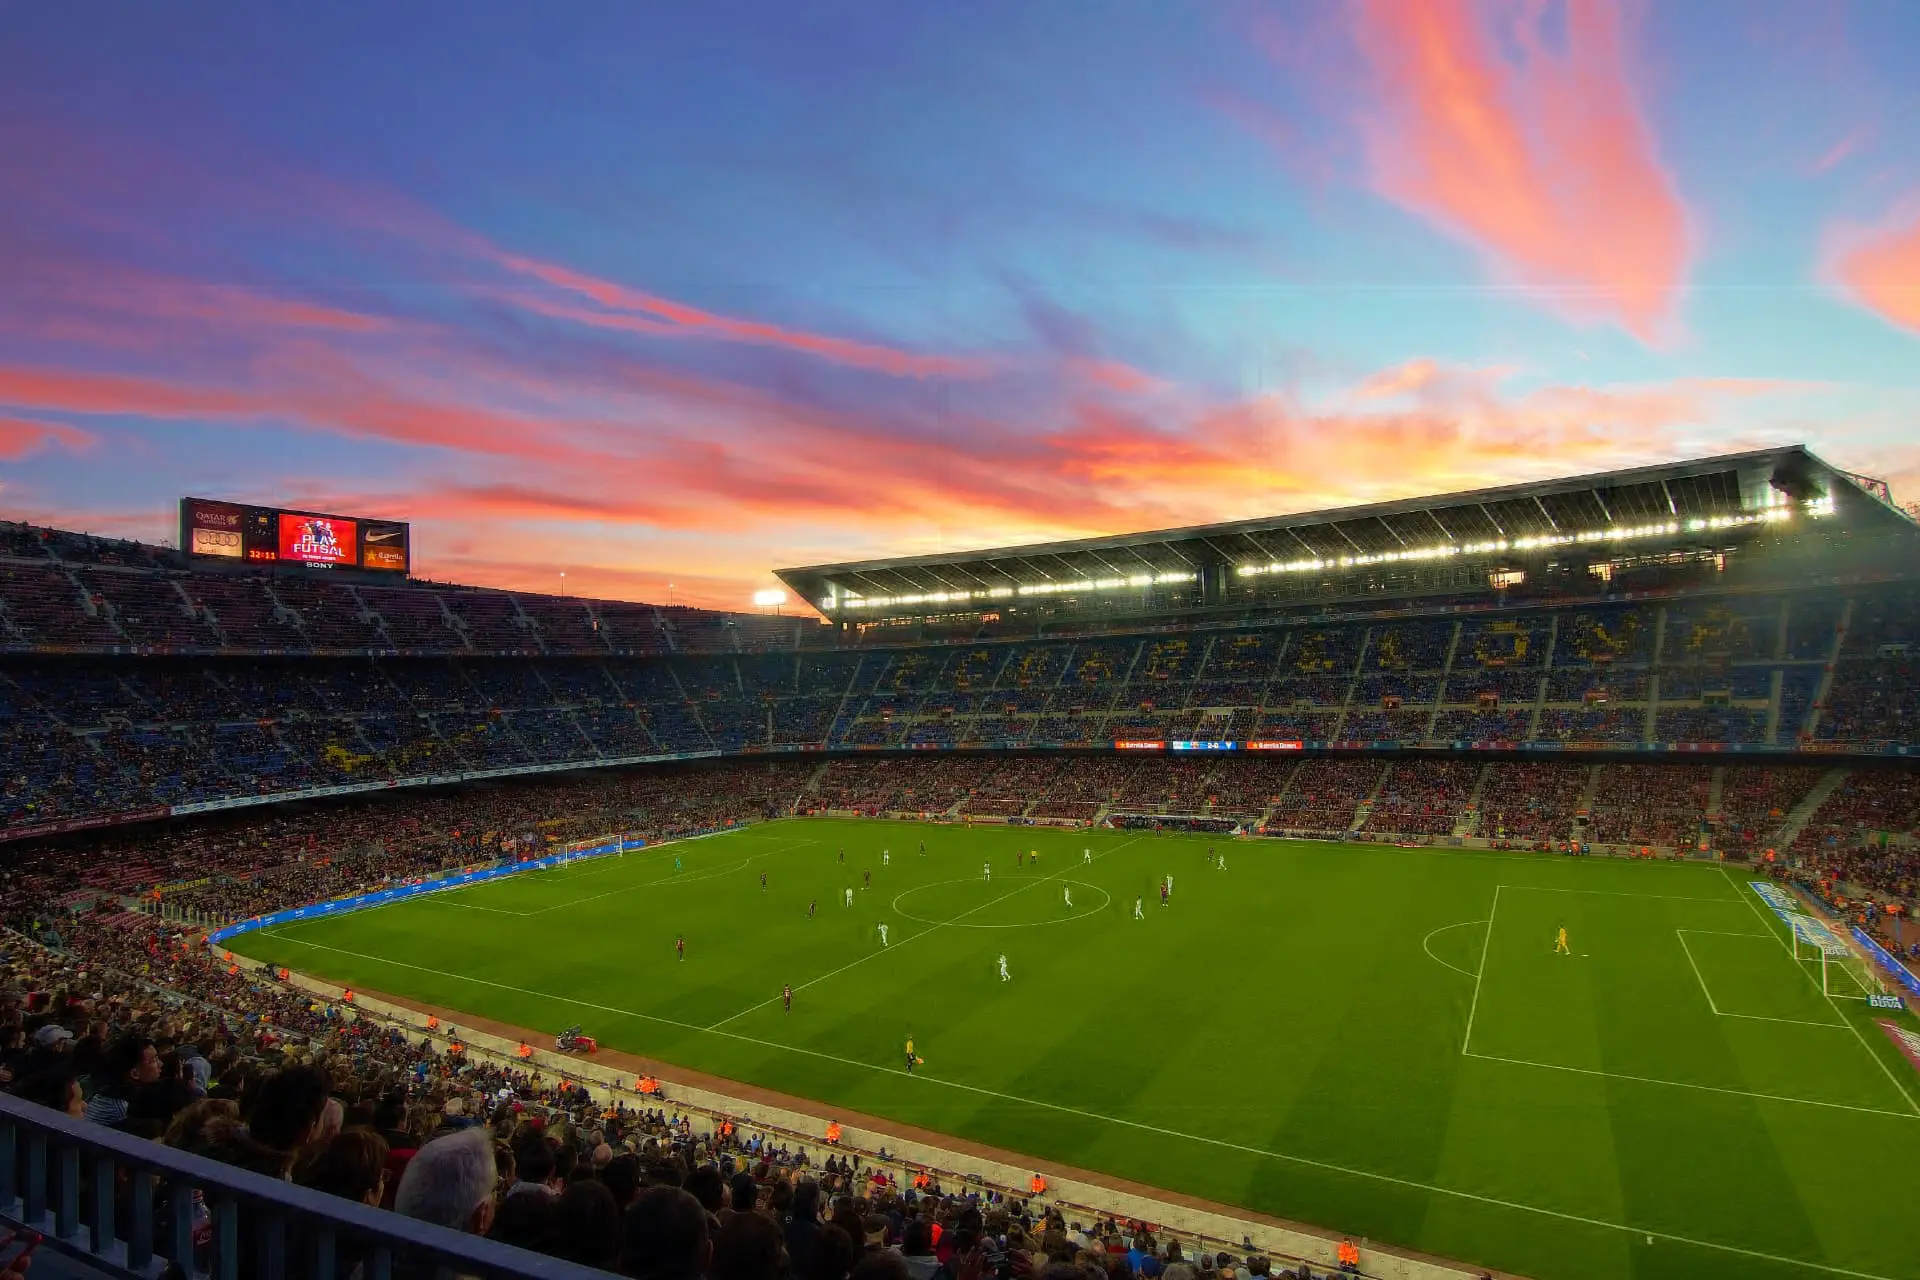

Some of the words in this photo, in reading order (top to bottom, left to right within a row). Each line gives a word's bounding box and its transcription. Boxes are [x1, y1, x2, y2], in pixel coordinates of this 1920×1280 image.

[195, 511, 226, 522] QATAR
[302, 534, 337, 545] PLAY
[293, 543, 345, 557] FUTSAL
